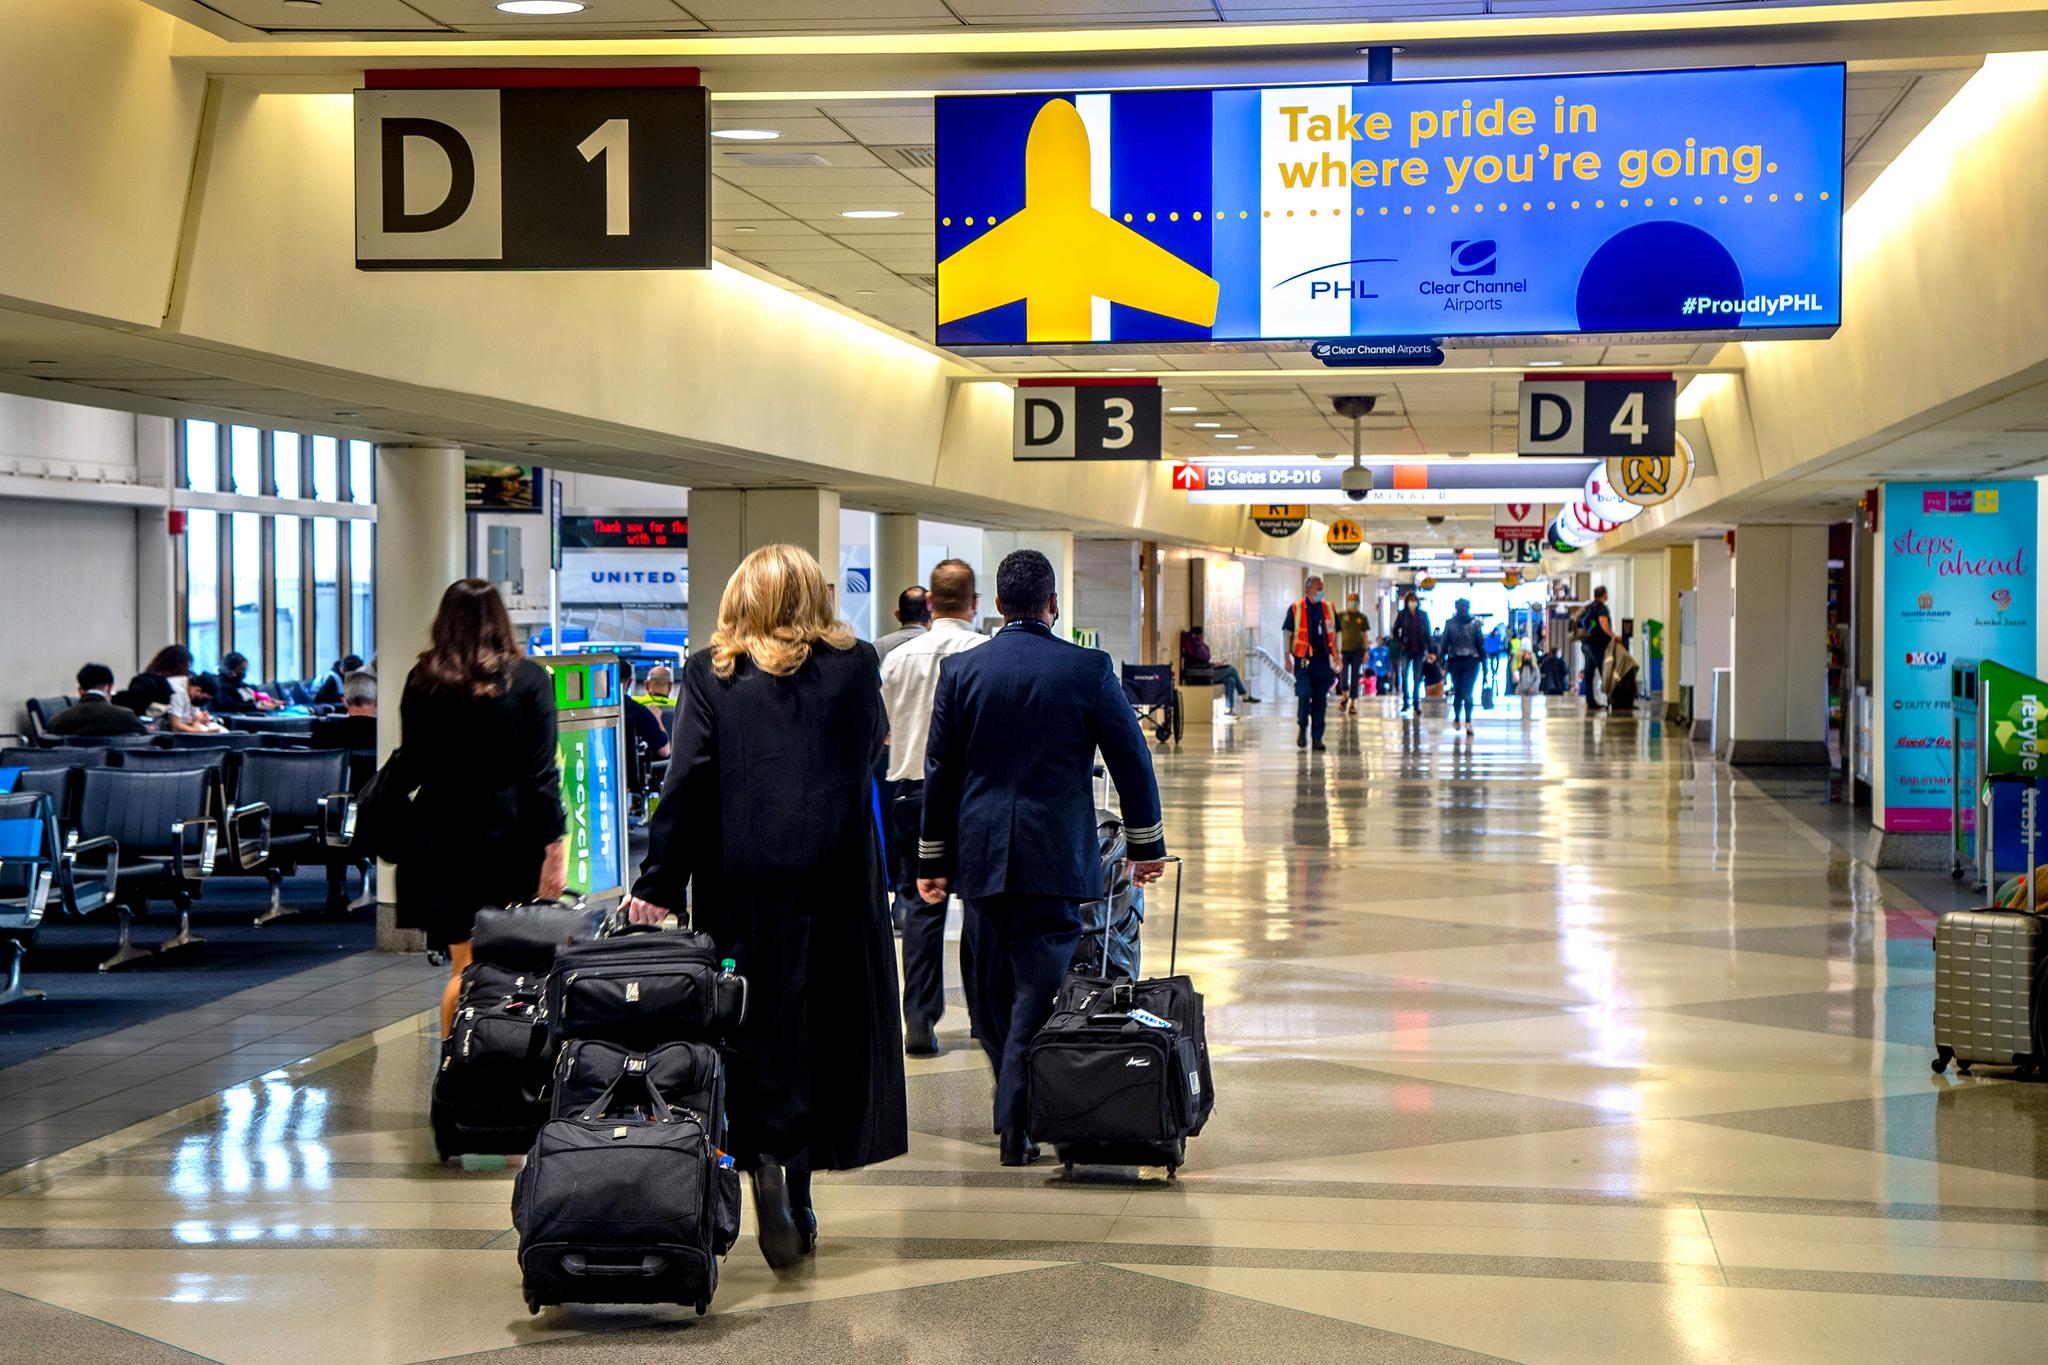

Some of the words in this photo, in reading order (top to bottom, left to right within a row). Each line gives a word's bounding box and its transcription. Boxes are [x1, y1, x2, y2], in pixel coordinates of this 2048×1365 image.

[1279, 104, 1392, 142] Take
[1410, 98, 1536, 148] pride
[1554, 95, 1597, 134] in
[1278, 151, 1429, 189] where
[1443, 143, 1602, 194] you're
[1618, 137, 1778, 188] going.
[381, 117, 475, 234] D
[576, 118, 630, 236] 1
[1310, 280, 1379, 300] PHL
[1419, 281, 1460, 295] Clear
[1463, 279, 1527, 294] Channel
[1443, 297, 1503, 314] Airports
[1681, 293, 1823, 316] #ProudlyPHL
[1331, 345, 1356, 355] Clear
[1357, 344, 1396, 355] Channel
[1397, 344, 1432, 356] Airports
[1025, 398, 1064, 446] D
[1102, 397, 1134, 449] 3
[1530, 392, 1573, 442] D
[1610, 392, 1649, 445] 4
[1226, 470, 1267, 485] Gates
[1269, 469, 1322, 485] D5-D16
[593, 520, 622, 533] Thank
[649, 521, 666, 533] for
[626, 532, 651, 545] with
[655, 535, 668, 545] us
[1502, 538, 1514, 553] D
[1893, 528, 1954, 568] steps
[1373, 547, 1384, 561] D
[1393, 547, 1403, 562] 5
[1939, 547, 2026, 576] ahead
[591, 571, 676, 583] UNITED
[1904, 700, 1932, 709] DUTY
[2017, 694, 2040, 771] recycle
[574, 742, 589, 884] recycle
[598, 756, 611, 857] trash
